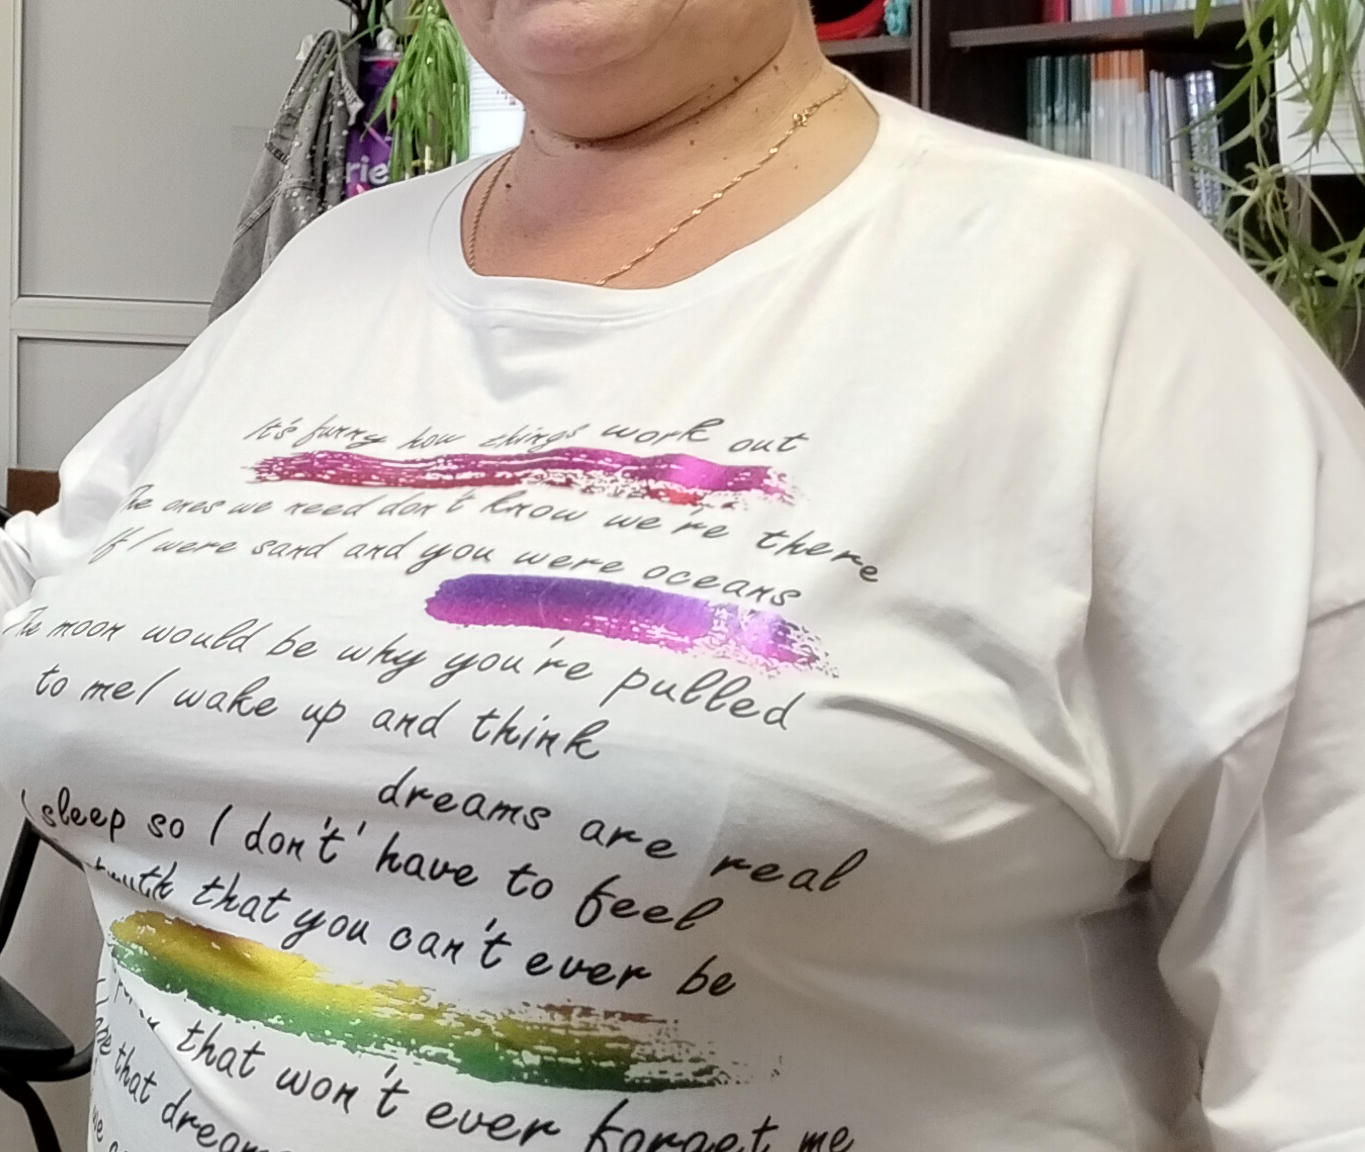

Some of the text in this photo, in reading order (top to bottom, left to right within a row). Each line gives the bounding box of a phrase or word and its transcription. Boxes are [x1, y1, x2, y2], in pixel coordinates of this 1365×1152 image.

[398, 426, 470, 450] how
[478, 422, 590, 452] things
[601, 417, 724, 443] work
[728, 431, 810, 453] out
[120, 484, 880, 584] The ones we need don't know we're there
[152, 540, 238, 555] were
[251, 532, 348, 559] sand
[343, 531, 428, 561] and
[405, 538, 492, 575] you
[514, 550, 626, 574] were
[643, 565, 803, 607] oceans
[34, 663, 69, 698] to
[80, 677, 137, 702] me
[173, 675, 279, 718] wake
[300, 698, 347, 743] up
[372, 699, 462, 739] and
[471, 706, 610, 761] think
[46, 618, 126, 642] moon
[141, 618, 274, 652] would
[266, 624, 318, 659] be
[336, 633, 428, 684] why
[429, 636, 595, 689] you're
[598, 666, 807, 731] pulled
[40, 786, 126, 844] sleep
[147, 813, 186, 839] so
[210, 804, 234, 846] I
[375, 831, 480, 888] have
[505, 862, 555, 900] to
[574, 874, 725, 931] feel
[377, 766, 870, 893] dreams are real
[192, 872, 292, 923] that
[281, 908, 370, 950] you
[389, 917, 512, 970] can't
[525, 950, 652, 990] ever
[677, 954, 737, 997] be
[114, 1040, 158, 1105] that
[176, 1019, 265, 1078] that
[275, 1063, 409, 1117] won't
[425, 1094, 561, 1151] ever
[798, 1125, 855, 1152] me
